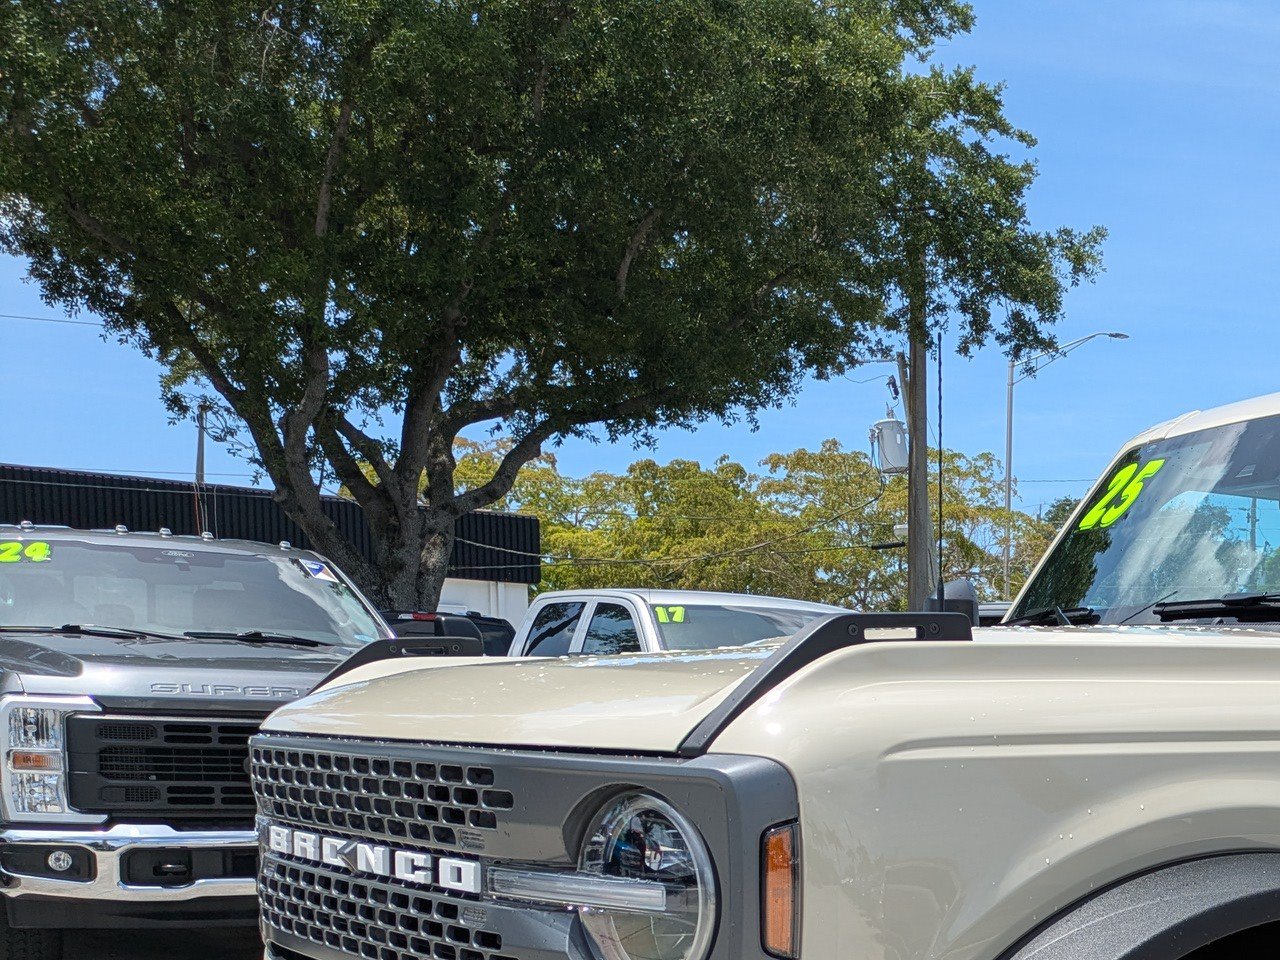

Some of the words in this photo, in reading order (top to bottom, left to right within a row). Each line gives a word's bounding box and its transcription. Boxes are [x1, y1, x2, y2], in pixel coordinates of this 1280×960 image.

[1079, 459, 1165, 531] 25
[0, 542, 51, 562] 24
[655, 606, 685, 623] 17
[151, 683, 300, 698] SUPER
[269, 825, 482, 894] BRONCO
